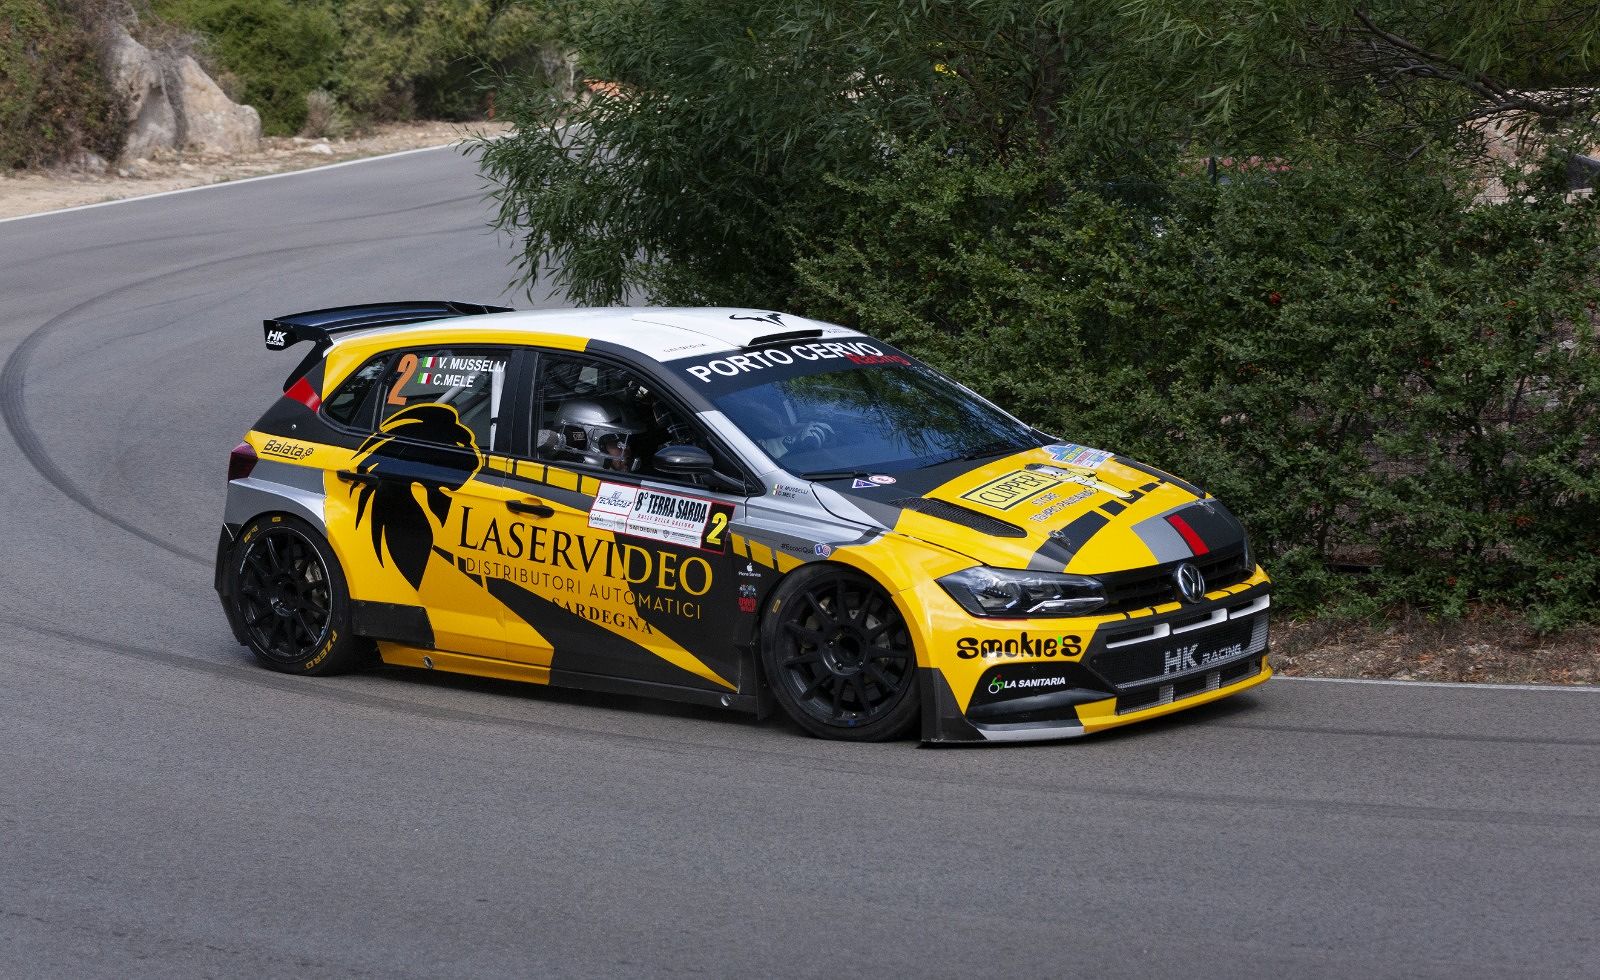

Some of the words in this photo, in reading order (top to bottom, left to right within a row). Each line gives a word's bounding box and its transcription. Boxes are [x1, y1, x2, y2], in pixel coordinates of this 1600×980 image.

[266, 330, 287, 341] HK
[438, 357, 448, 369] V.
[449, 357, 507, 373] MUSSELLI
[685, 350, 796, 383] PORTO
[790, 342, 884, 361] CERVO
[387, 353, 418, 406] 2
[433, 373, 476, 388] C.MELE
[263, 440, 304, 457] Balata
[980, 475, 1046, 502] CLIPPER
[647, 494, 677, 518] TERRA
[675, 499, 708, 523] SARDA
[706, 512, 728, 545] 2
[457, 505, 714, 597] LASERVIDEO
[465, 557, 582, 595] DISTRIBUTORI
[588, 583, 701, 620] AUTOMATICI
[551, 597, 654, 635] SARDEGNA
[1164, 643, 1199, 676] HK
[1201, 643, 1242, 666] RACING
[1003, 680, 1017, 689] LA
[1018, 677, 1066, 688] SANITARIA
